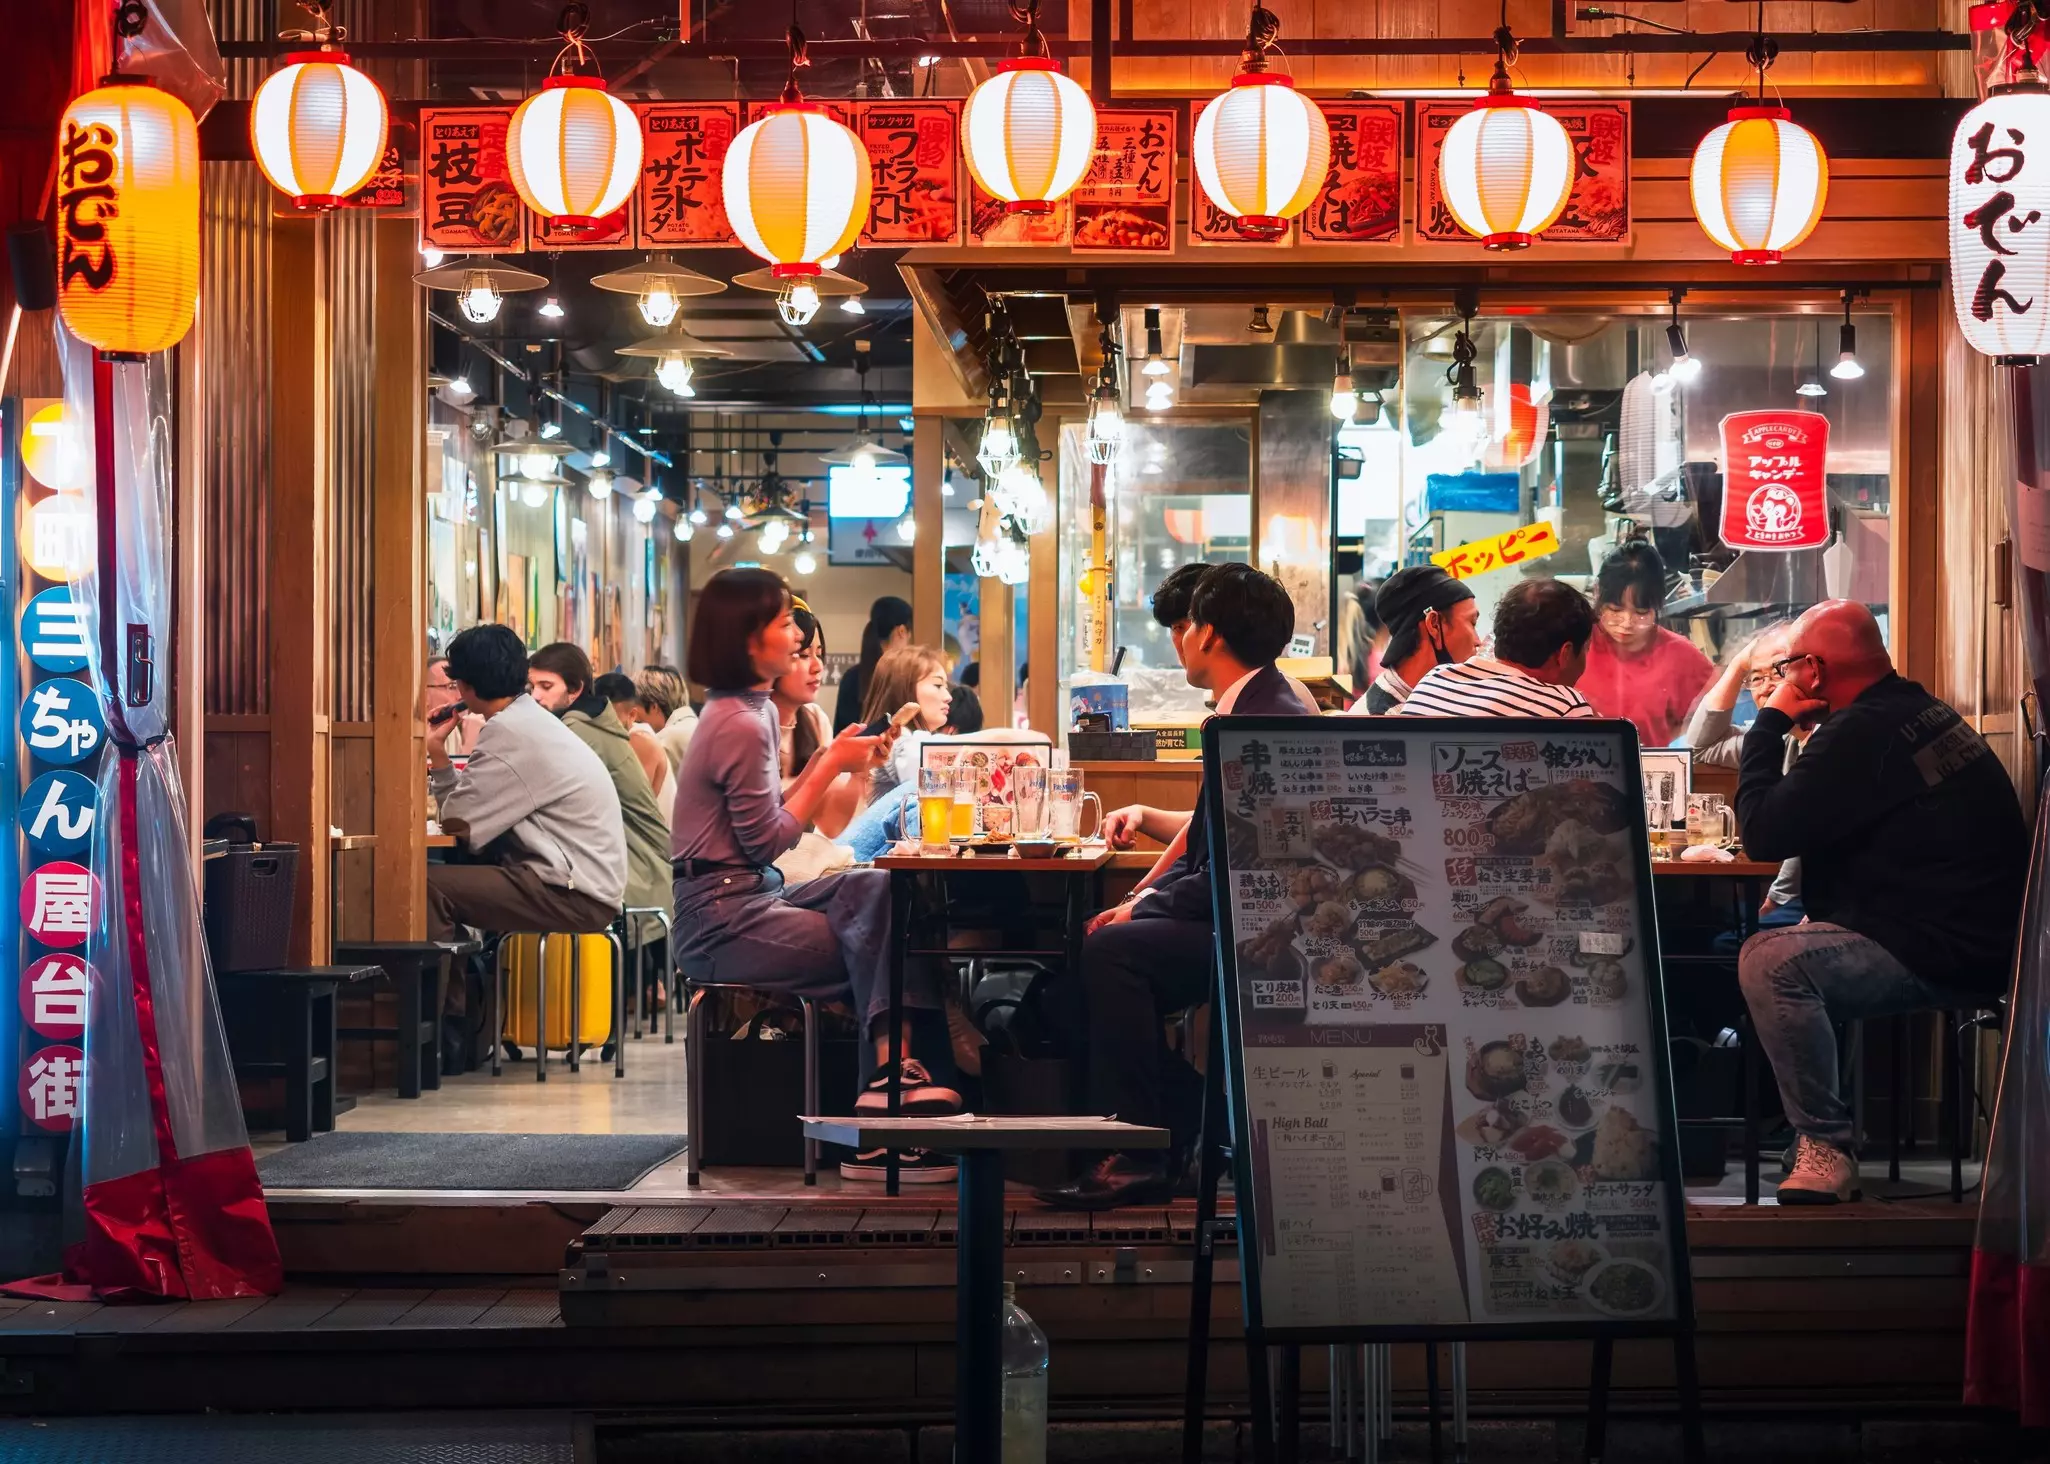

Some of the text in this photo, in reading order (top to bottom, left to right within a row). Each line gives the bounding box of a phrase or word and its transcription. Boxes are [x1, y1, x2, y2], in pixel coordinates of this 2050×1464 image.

[651, 118, 698, 130] とりあえず
[868, 114, 914, 127] サックサク
[1330, 117, 1354, 129] ース
[435, 126, 479, 138] とりあえず
[1136, 118, 1167, 193] おでん
[672, 132, 708, 221] ポテト
[888, 131, 919, 225] フライド
[428, 141, 484, 230] 枝豆
[645, 157, 681, 234] サラダ
[872, 156, 896, 235] ポテト
[61, 122, 117, 293] おでん
[1963, 121, 2042, 323] おでん
[1747, 456, 1803, 467] アップル
[1748, 468, 1805, 480] キャンデー
[1445, 530, 1549, 579] ホッピー
[826, 654, 860, 665] TOILE
[1155, 738, 1185, 748] 然が育てた
[1438, 746, 1505, 773] ソース
[1539, 741, 1612, 769] 銀ちゃん
[1237, 739, 1278, 819] 串焼き
[1456, 768, 1532, 797] 焼そば
[1330, 804, 1413, 827] 牛ハラミ串
[1443, 828, 1495, 847] 800円
[1240, 872, 1280, 888] 鶏もも
[1256, 900, 1282, 910] 500円
[1254, 981, 1301, 994] とり皮棒
[1313, 1000, 1340, 1010] とり天
[1310, 1029, 1373, 1044] MENU
[1253, 1066, 1310, 1080] 生ビール
[1349, 1068, 1383, 1080] Special
[1272, 1116, 1329, 1131] High Ball
[1473, 1152, 1503, 1162] トマト
[1358, 1189, 1382, 1201] 焼酎
[1582, 1181, 1656, 1198] ポテトサラダ
[1279, 1218, 1314, 1231] 酎ハイ
[1495, 1211, 1600, 1241] お好み焼
